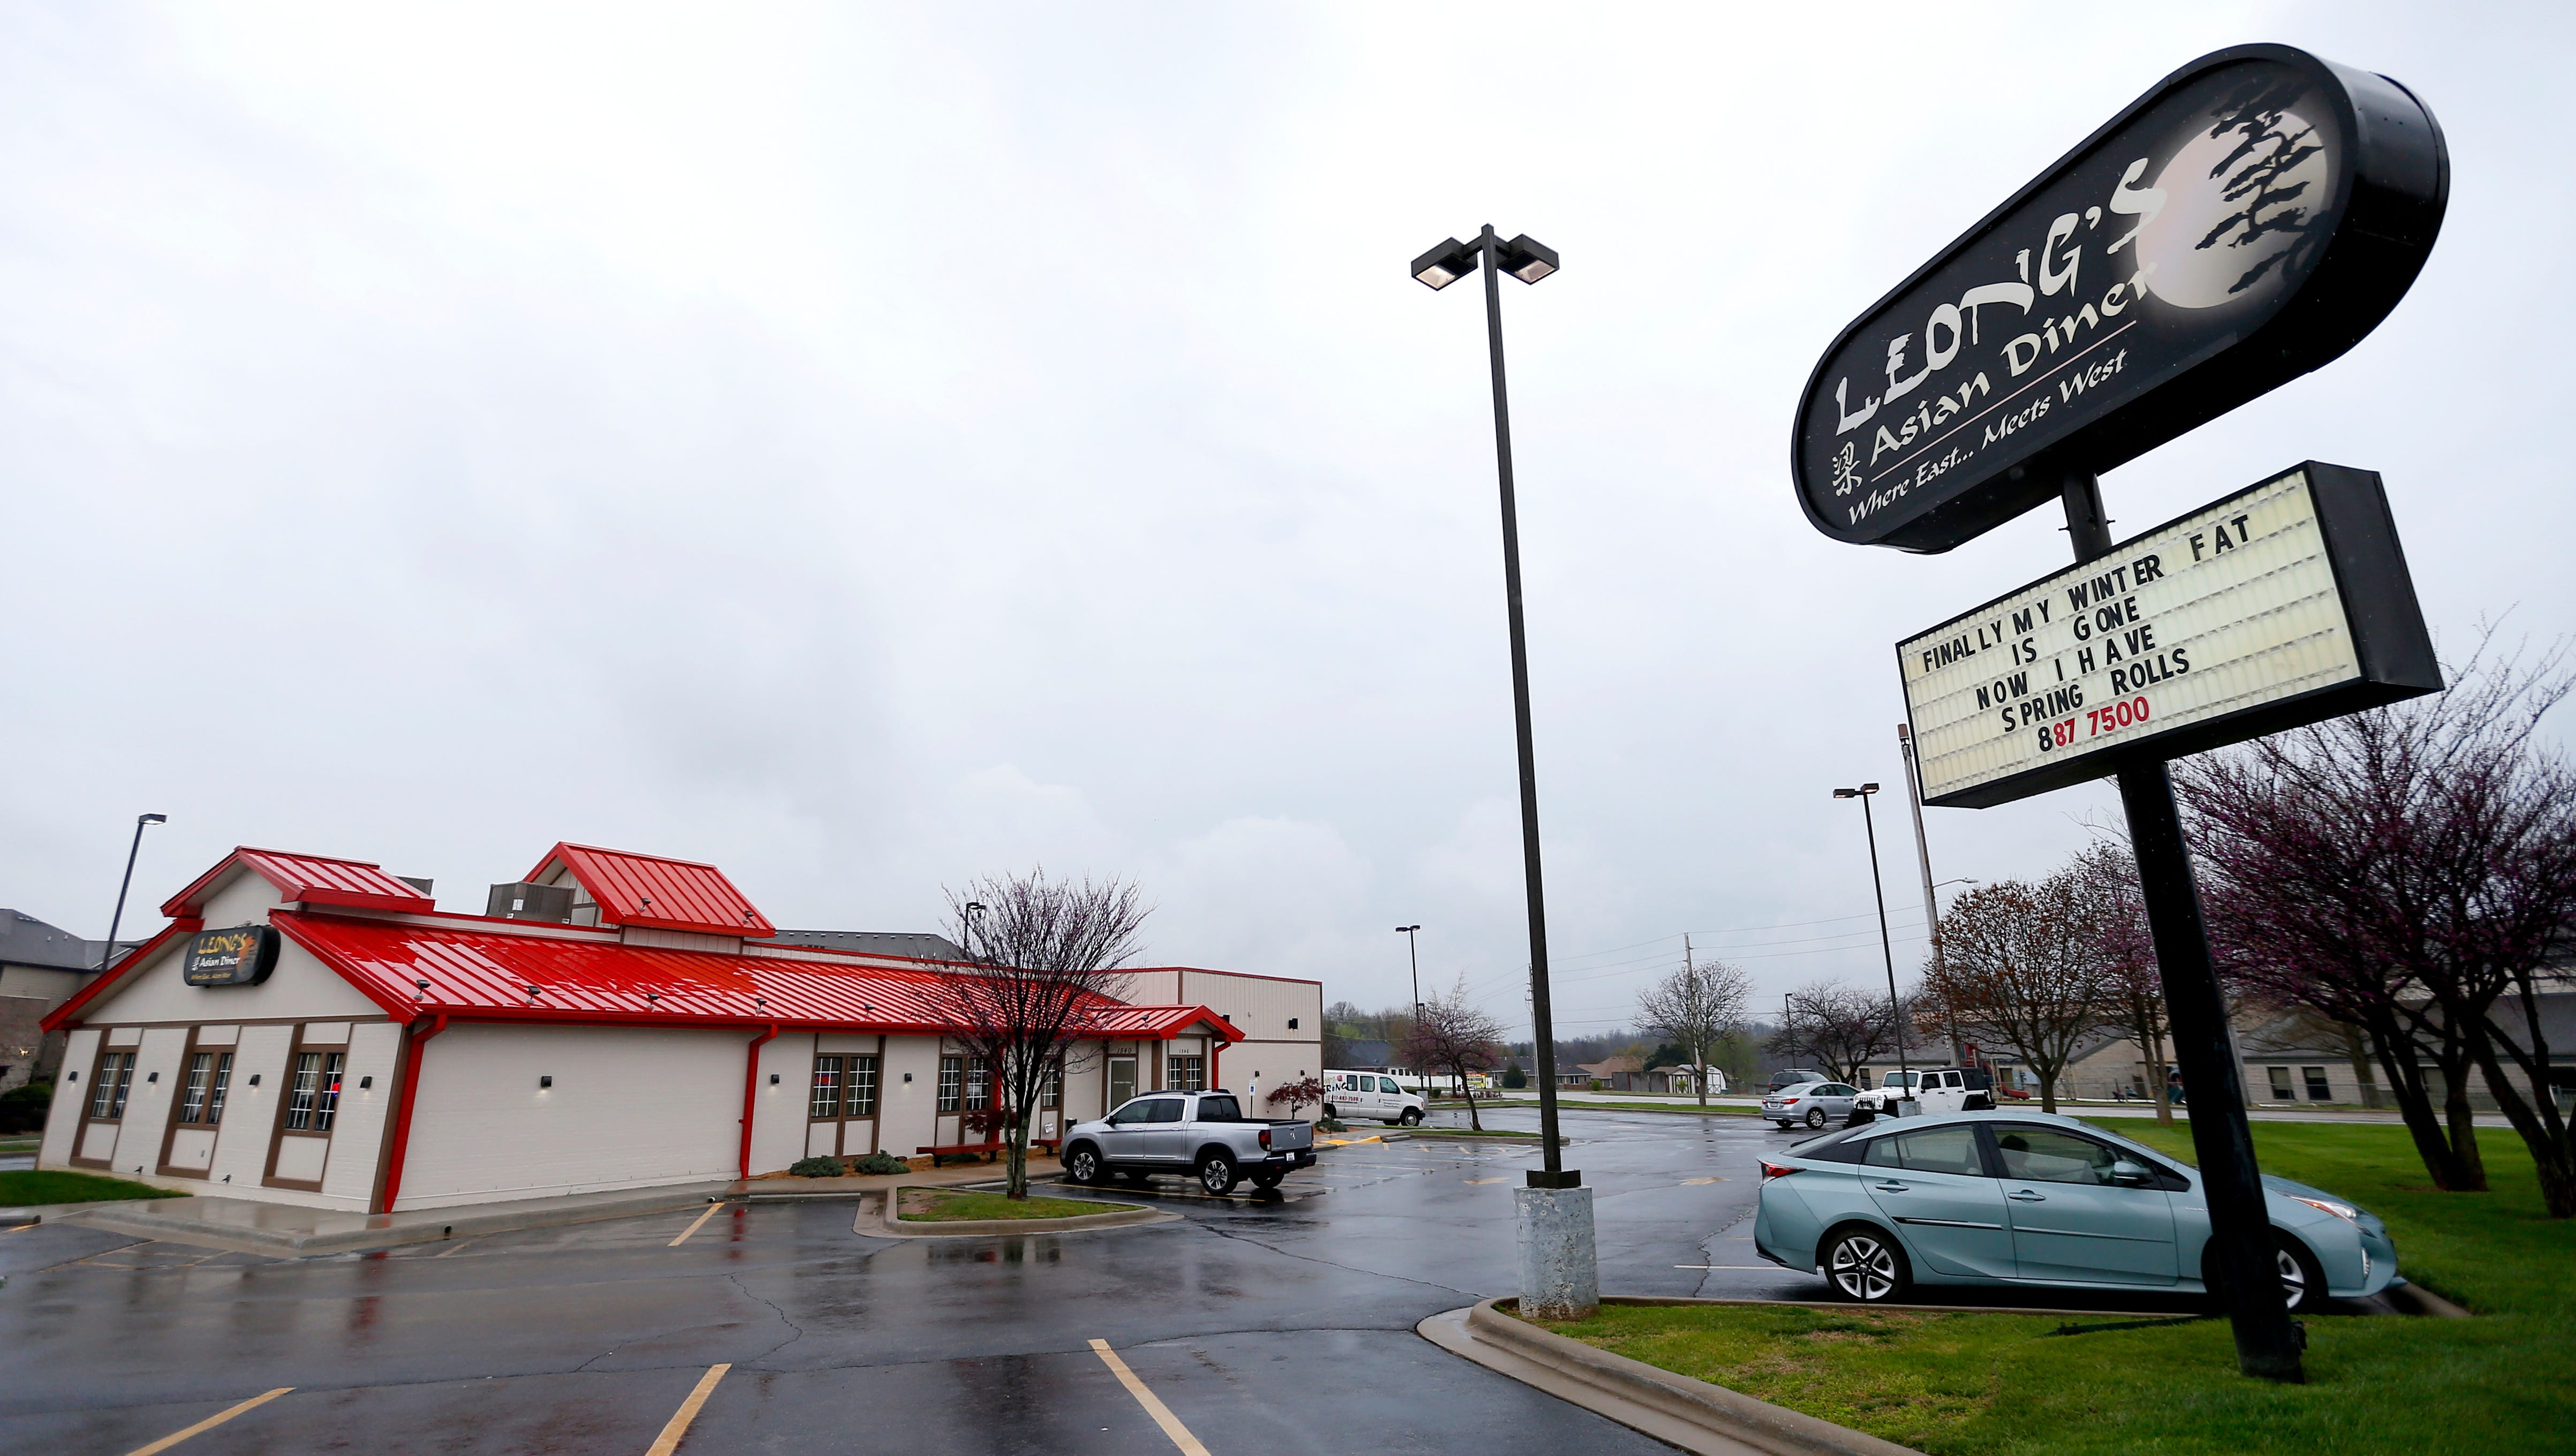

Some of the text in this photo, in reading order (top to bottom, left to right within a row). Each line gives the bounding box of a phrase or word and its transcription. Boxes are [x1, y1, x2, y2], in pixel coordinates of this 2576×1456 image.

[1836, 157, 2168, 436] LEONG'S
[1870, 262, 2157, 467] Asian Diner
[1848, 348, 2127, 525] Where East... Meets West
[1923, 514, 2248, 673] FINALLY MY WINTER FAT
[2011, 595, 2140, 666] IS GONE
[1976, 624, 2156, 710] NOW I HAVE
[2002, 648, 2189, 733] SPRING ROLLS
[2037, 696, 2150, 752] 887 7500
[199, 956, 219, 967] Asian
[219, 955, 241, 966] Diner
